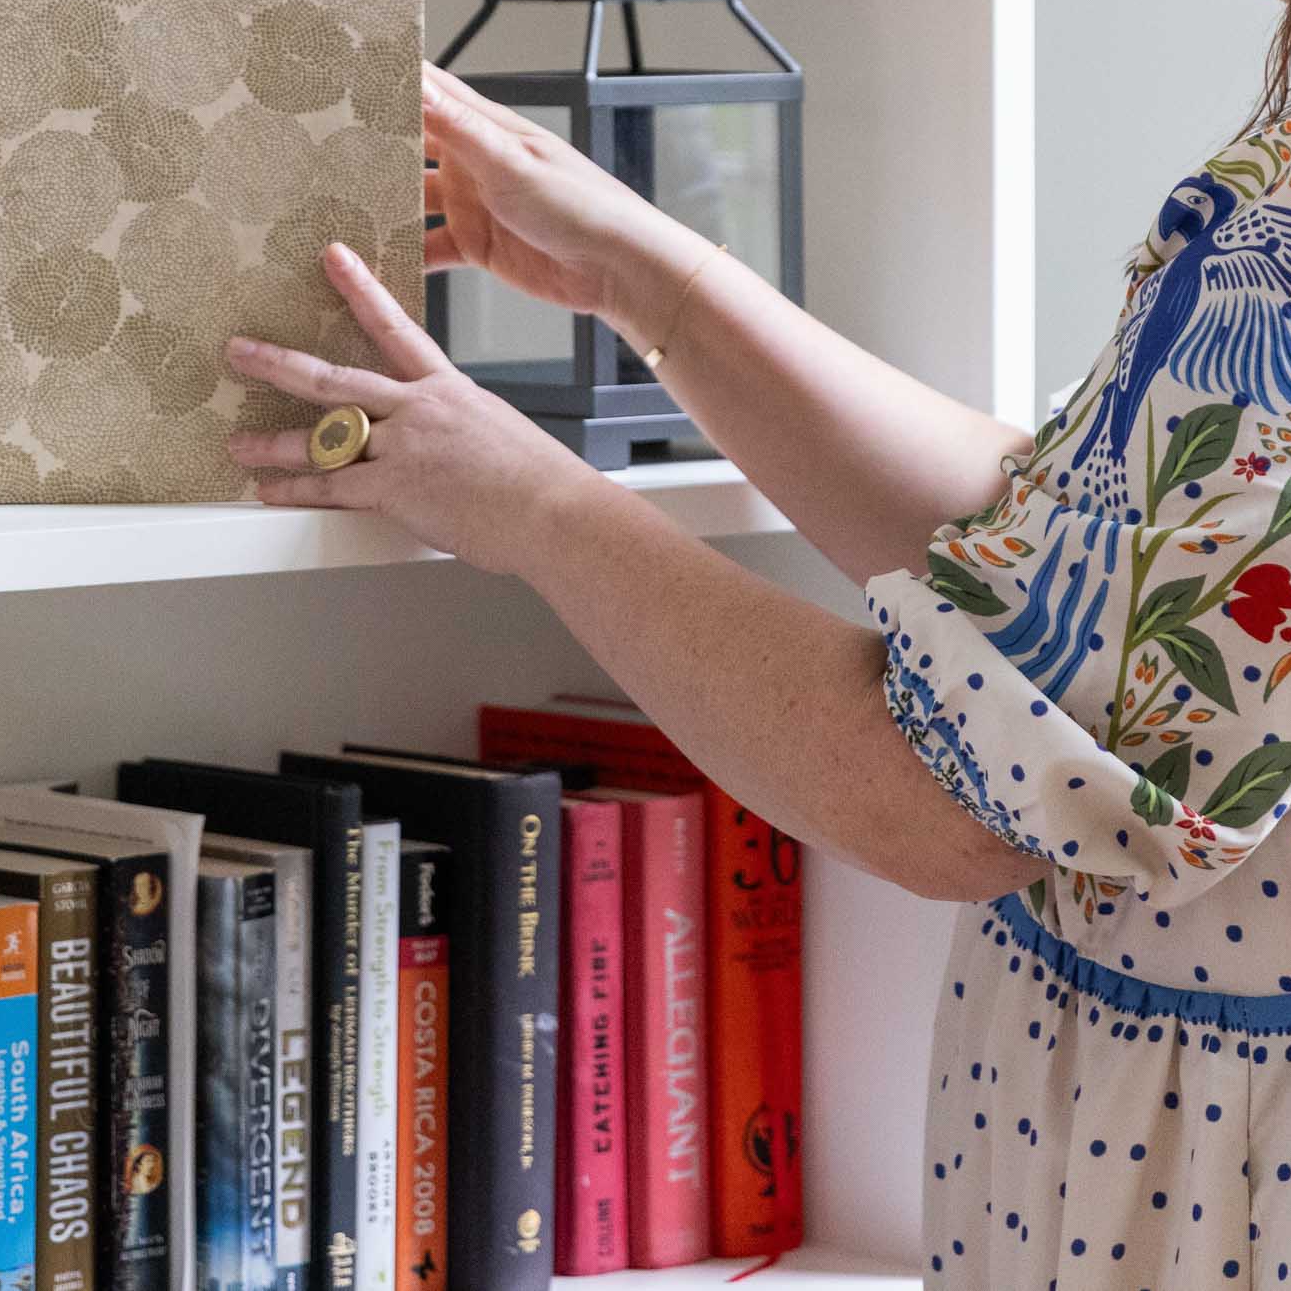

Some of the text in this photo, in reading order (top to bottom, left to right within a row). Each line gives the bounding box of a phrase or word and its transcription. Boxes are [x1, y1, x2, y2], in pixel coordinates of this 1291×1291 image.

[344, 828, 361, 866] The
[344, 872, 361, 947] Murder
[518, 814, 542, 978] ON THE BRINK
[344, 953, 359, 977] of
[368, 840, 395, 1116] From Strength to Strength
[50, 937, 91, 1121] BEAUTIFUL
[413, 980, 437, 1080] COSTA
[594, 1014, 610, 1153] CATCHING
[665, 908, 700, 1188] ALLEGIANT
[8, 1040, 29, 1224] South Africa,
[250, 997, 272, 1258] DIVERGENT
[281, 1029, 306, 1229] LEGEND
[413, 1086, 437, 1156] RICA
[49, 1130, 90, 1243] CHAOS
[368, 1151, 378, 1223] BROOKS
[413, 1162, 437, 1237] 2008
